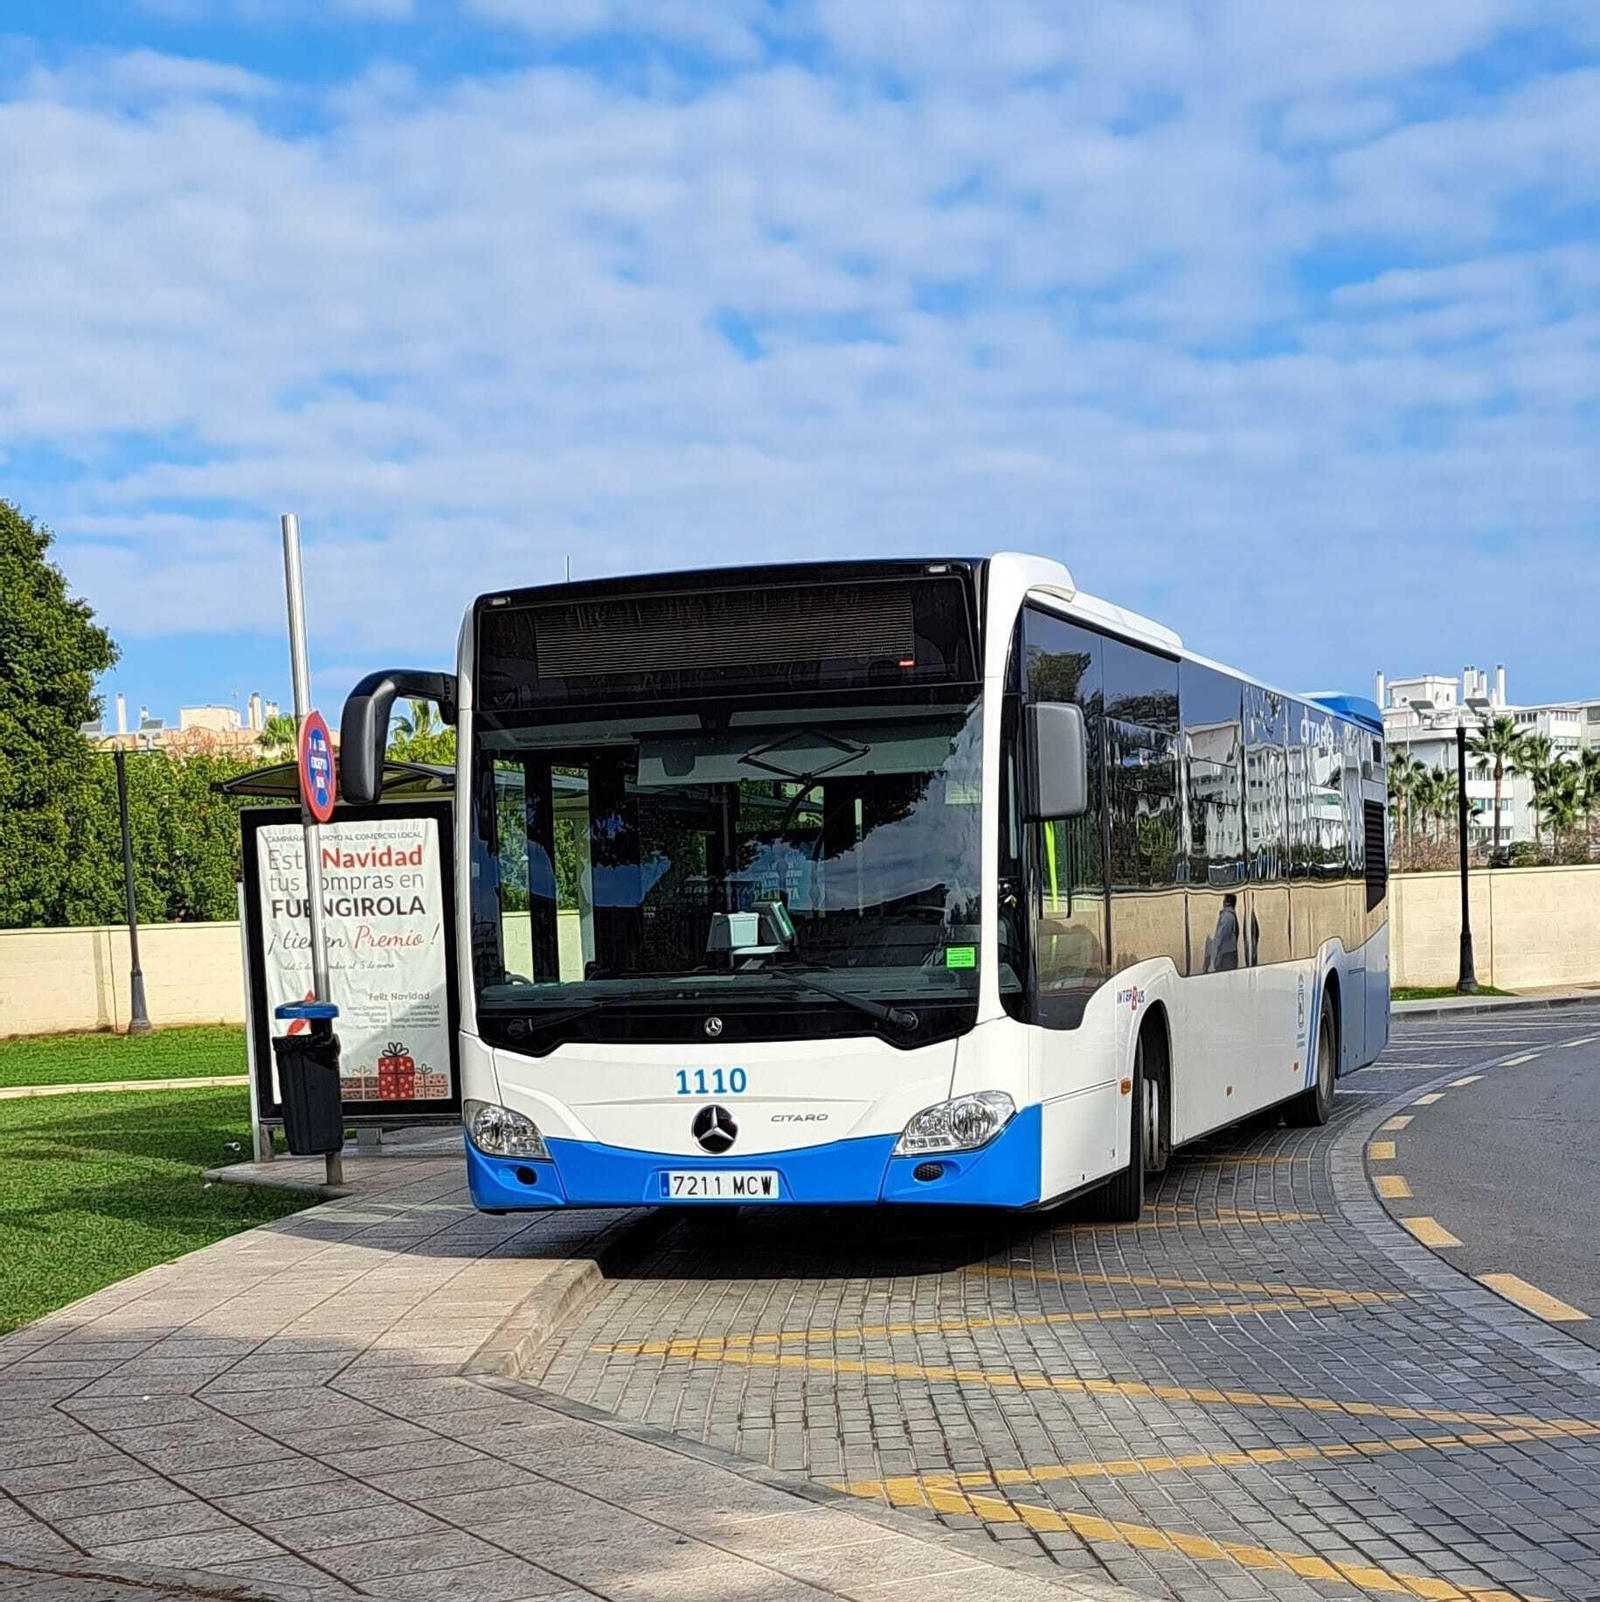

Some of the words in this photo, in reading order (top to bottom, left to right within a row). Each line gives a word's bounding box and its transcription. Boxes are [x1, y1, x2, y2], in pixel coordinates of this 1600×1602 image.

[345, 833, 354, 841] AL
[355, 832, 397, 841] COMERCIO
[398, 830, 423, 840] LOCAL
[268, 848, 303, 871] Est
[322, 844, 423, 869] Navidad
[270, 873, 300, 892] tus
[322, 873, 394, 894] ompras
[400, 873, 424, 889] en
[359, 961, 366, 970] 5
[369, 992, 388, 1001] Feliz
[391, 991, 431, 1001] Navidad
[675, 1067, 747, 1095] 1110
[771, 1113, 829, 1122] CITARO
[673, 1176, 721, 1196] 7211
[733, 1175, 772, 1196] MCW
